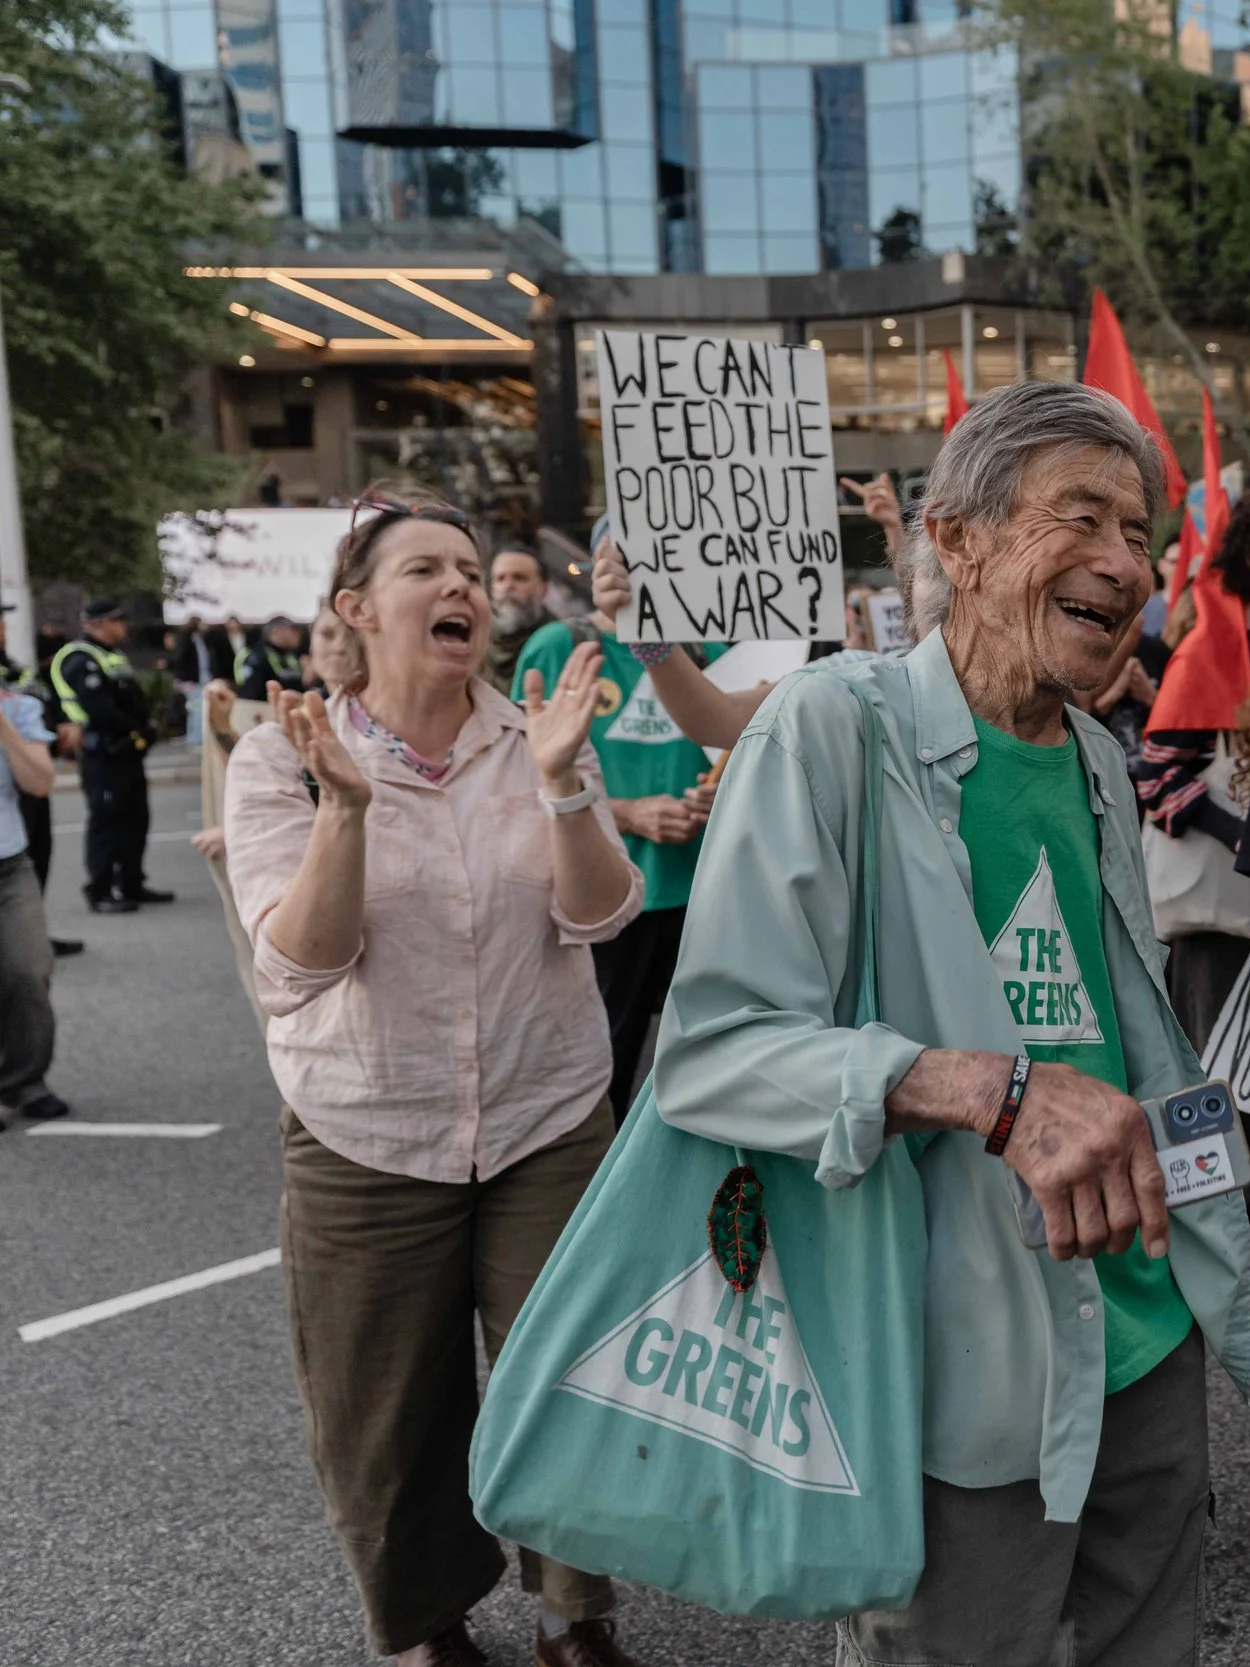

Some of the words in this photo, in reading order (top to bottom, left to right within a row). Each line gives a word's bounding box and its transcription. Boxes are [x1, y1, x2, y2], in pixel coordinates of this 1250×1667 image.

[602, 331, 688, 398] WE
[612, 398, 735, 464] FEED
[735, 401, 829, 460] THE
[616, 464, 723, 540] POOR
[730, 463, 818, 533] BUT
[615, 534, 684, 574] WE
[700, 533, 760, 567] CAN
[766, 530, 838, 565] FUND
[638, 582, 664, 640] A
[669, 566, 823, 640] WAR?
[1015, 927, 1062, 974] THE
[1003, 980, 1082, 1026] REENS
[623, 1317, 812, 1458] GREENS
